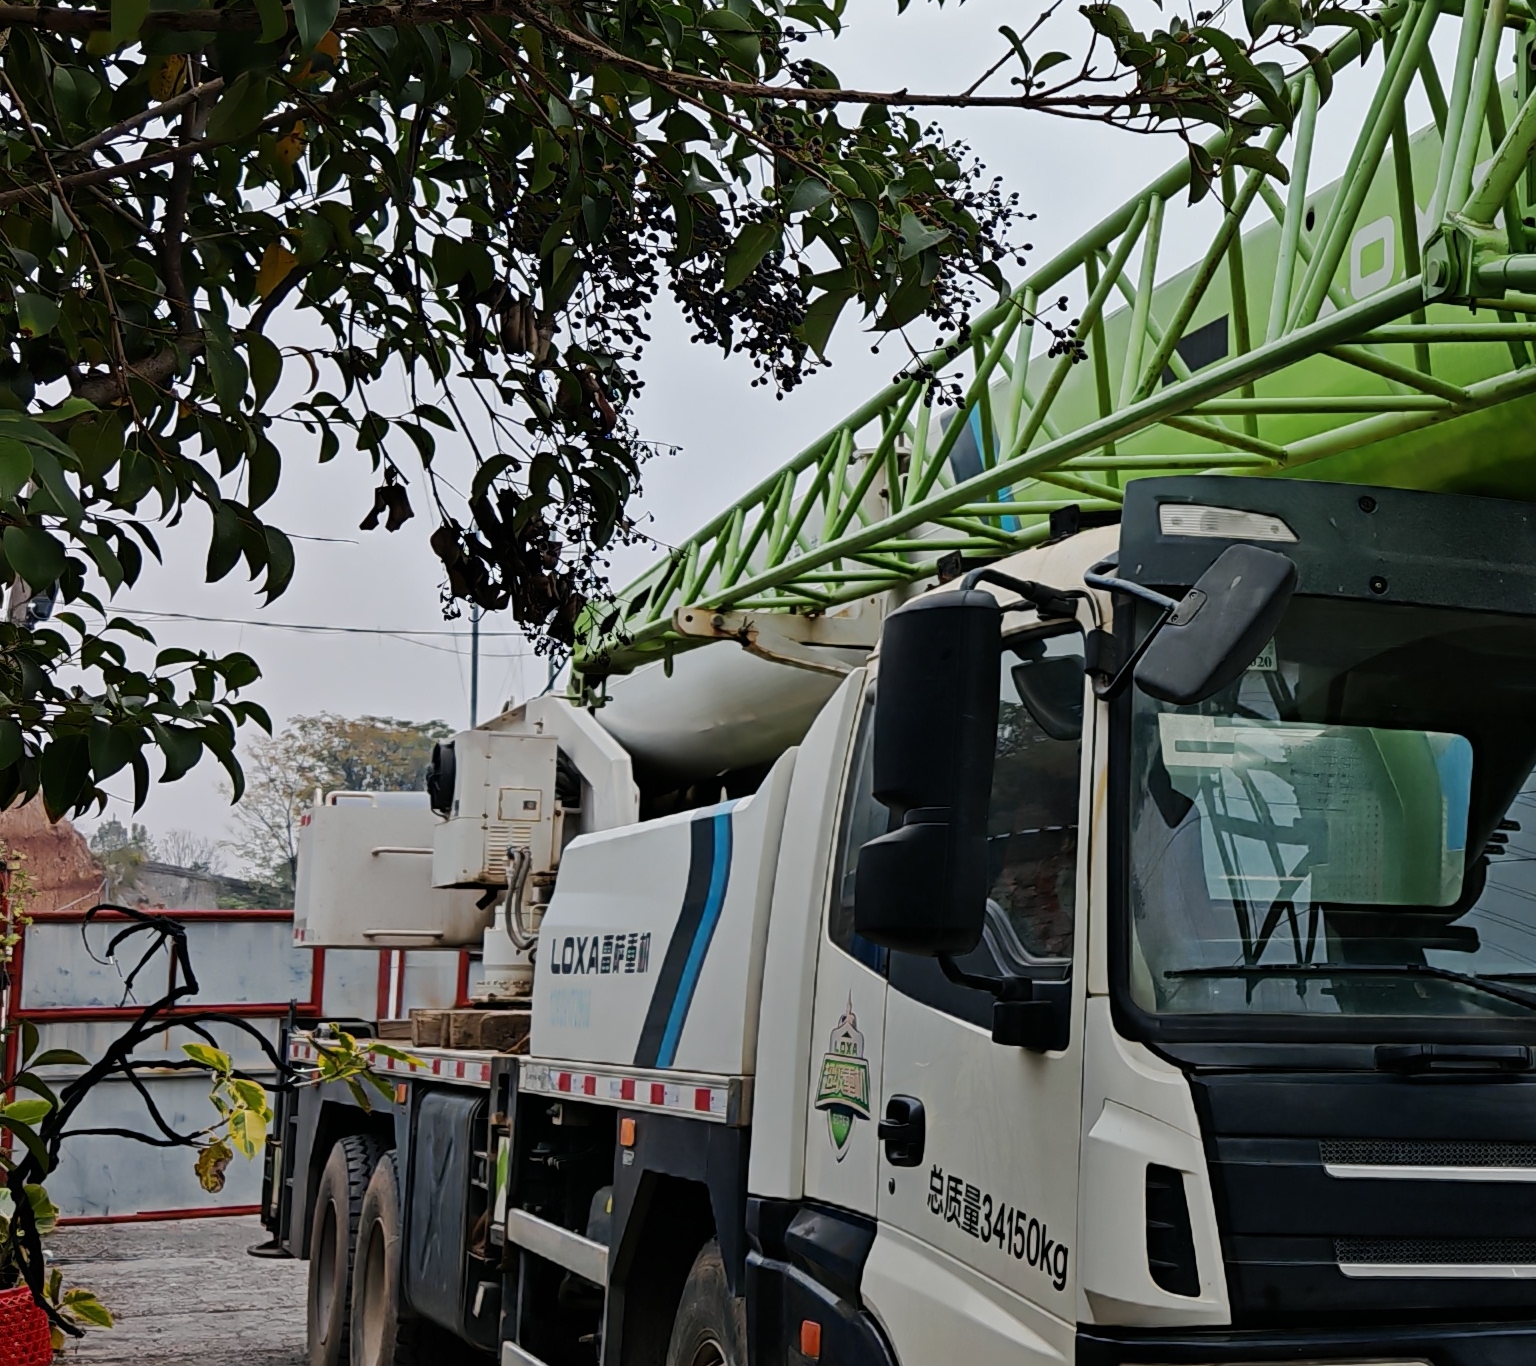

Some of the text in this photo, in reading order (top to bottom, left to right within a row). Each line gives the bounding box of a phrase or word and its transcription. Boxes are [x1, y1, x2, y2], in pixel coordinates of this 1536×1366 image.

[834, 1040, 858, 1056] LOXA
[927, 1164, 1068, 1291] 总质量34150kg
